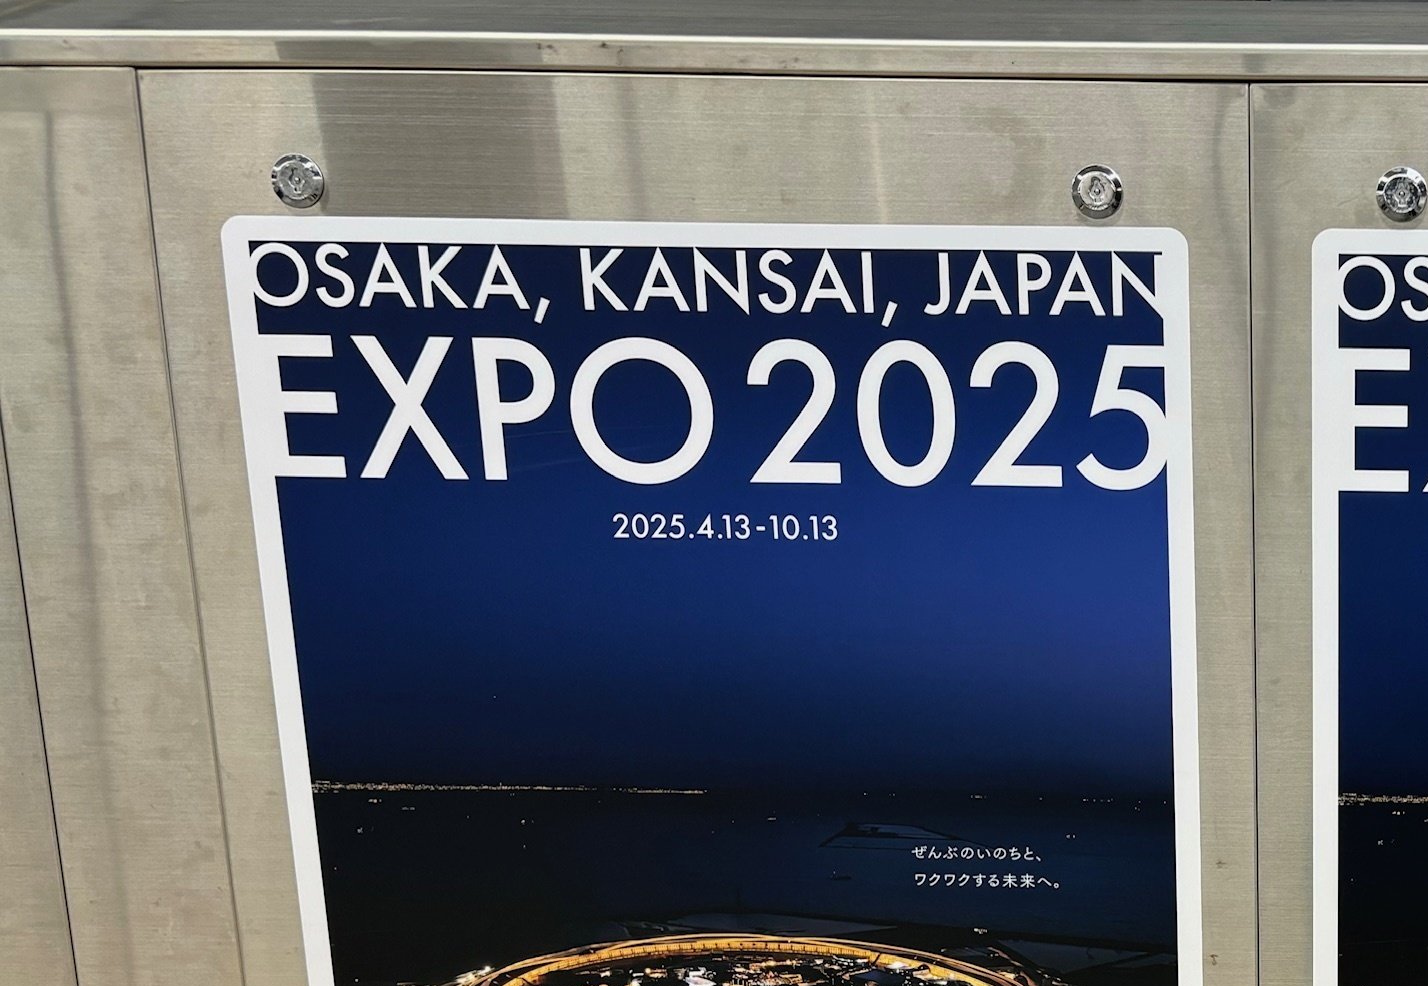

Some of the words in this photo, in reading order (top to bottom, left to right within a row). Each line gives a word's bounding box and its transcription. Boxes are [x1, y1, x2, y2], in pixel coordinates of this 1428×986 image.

[248, 242, 548, 324] OSAKA,
[579, 247, 898, 327] KANSAI,
[925, 251, 1163, 320] JAPAN
[256, 334, 714, 485] EXPO
[745, 338, 1164, 491] 2025
[612, 513, 839, 542] 2025.4.13-10.13
[911, 845, 1042, 862] ぜんぶのいのちと、
[914, 873, 1060, 889] ワクワクする未来へ。
